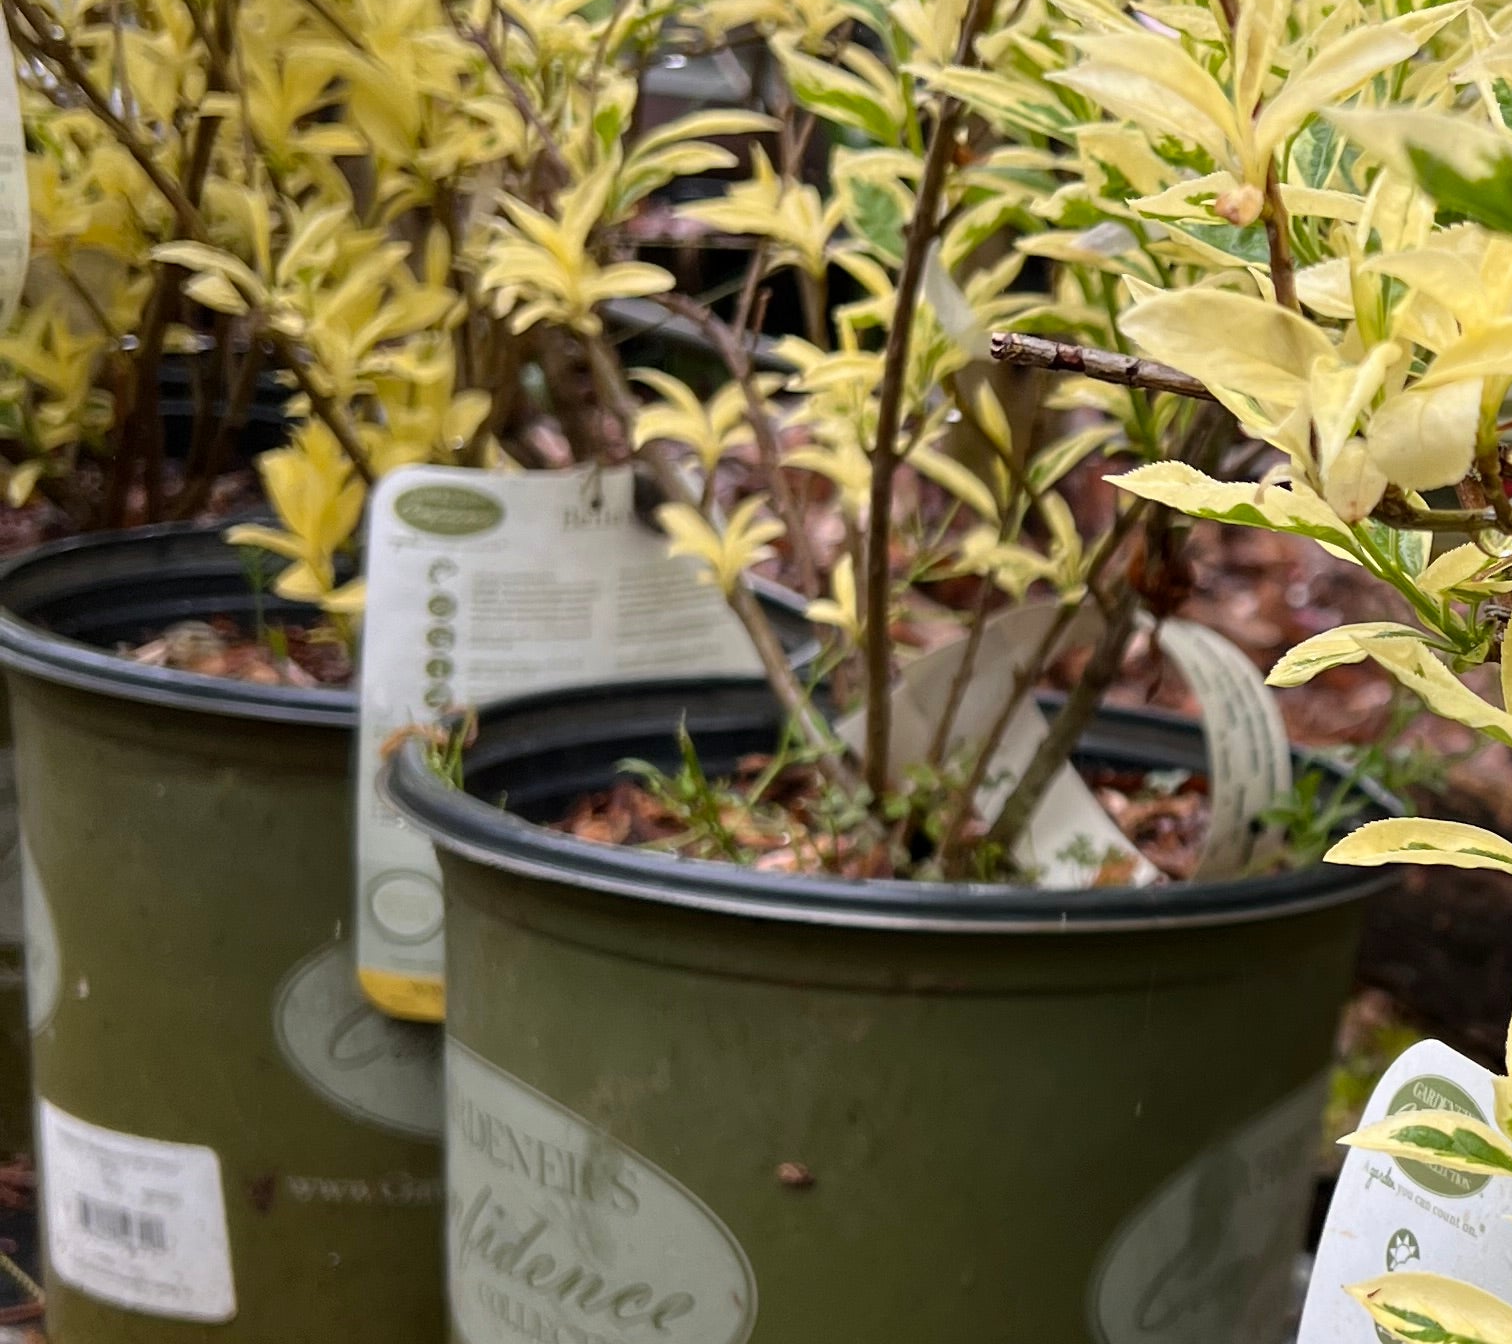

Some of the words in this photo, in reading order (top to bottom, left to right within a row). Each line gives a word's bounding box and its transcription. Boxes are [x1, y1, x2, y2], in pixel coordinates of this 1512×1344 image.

[1395, 1184, 1415, 1202] you
[1414, 1193, 1432, 1211] can
[1433, 1203, 1461, 1229] count
